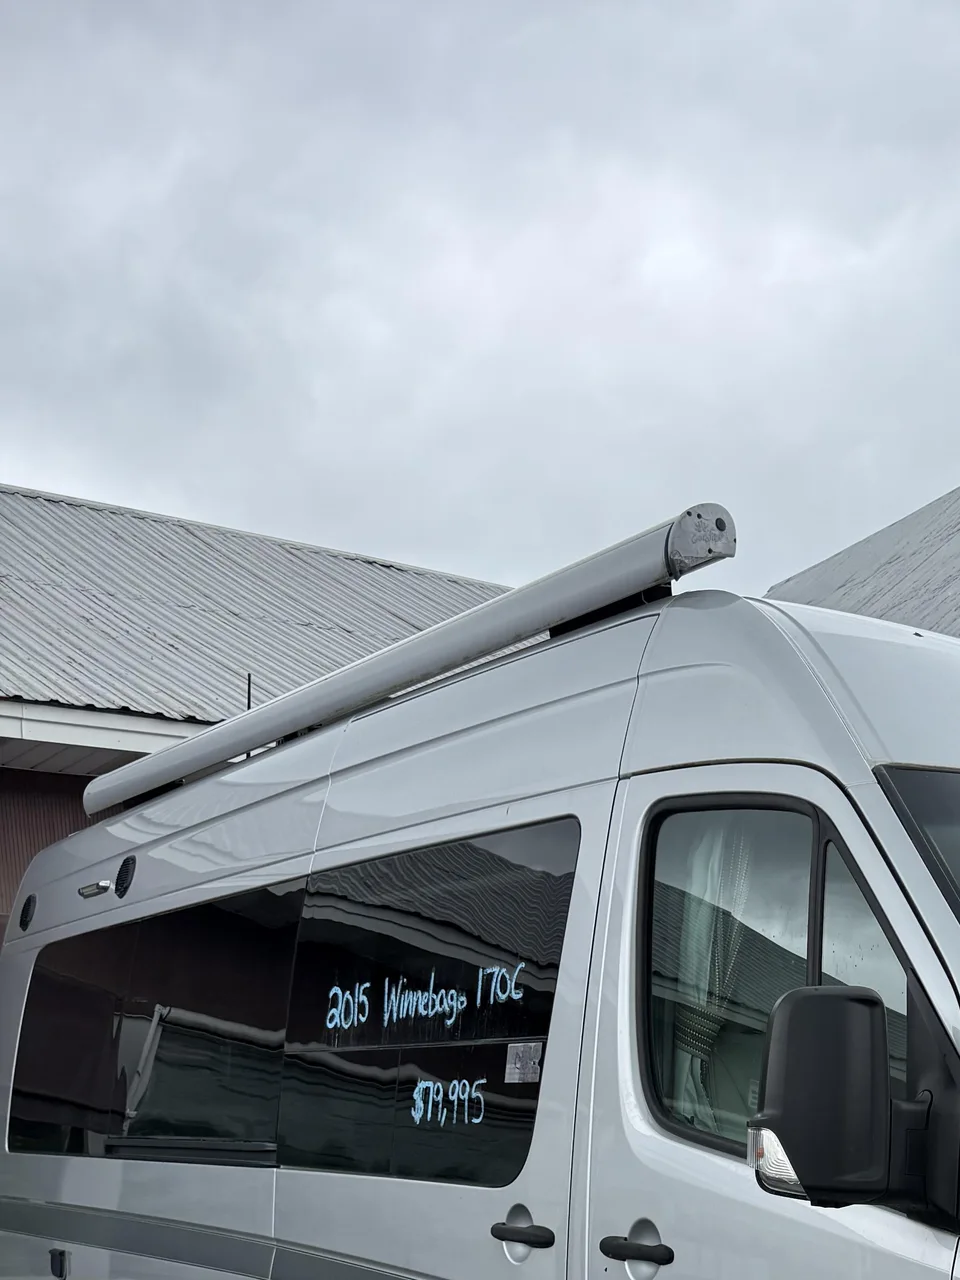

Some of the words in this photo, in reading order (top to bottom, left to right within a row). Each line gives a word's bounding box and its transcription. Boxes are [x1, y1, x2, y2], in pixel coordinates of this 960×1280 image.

[326, 982, 371, 1030] 2015
[383, 966, 467, 1028] Winnebago
[411, 1077, 487, 1128] $79,995
